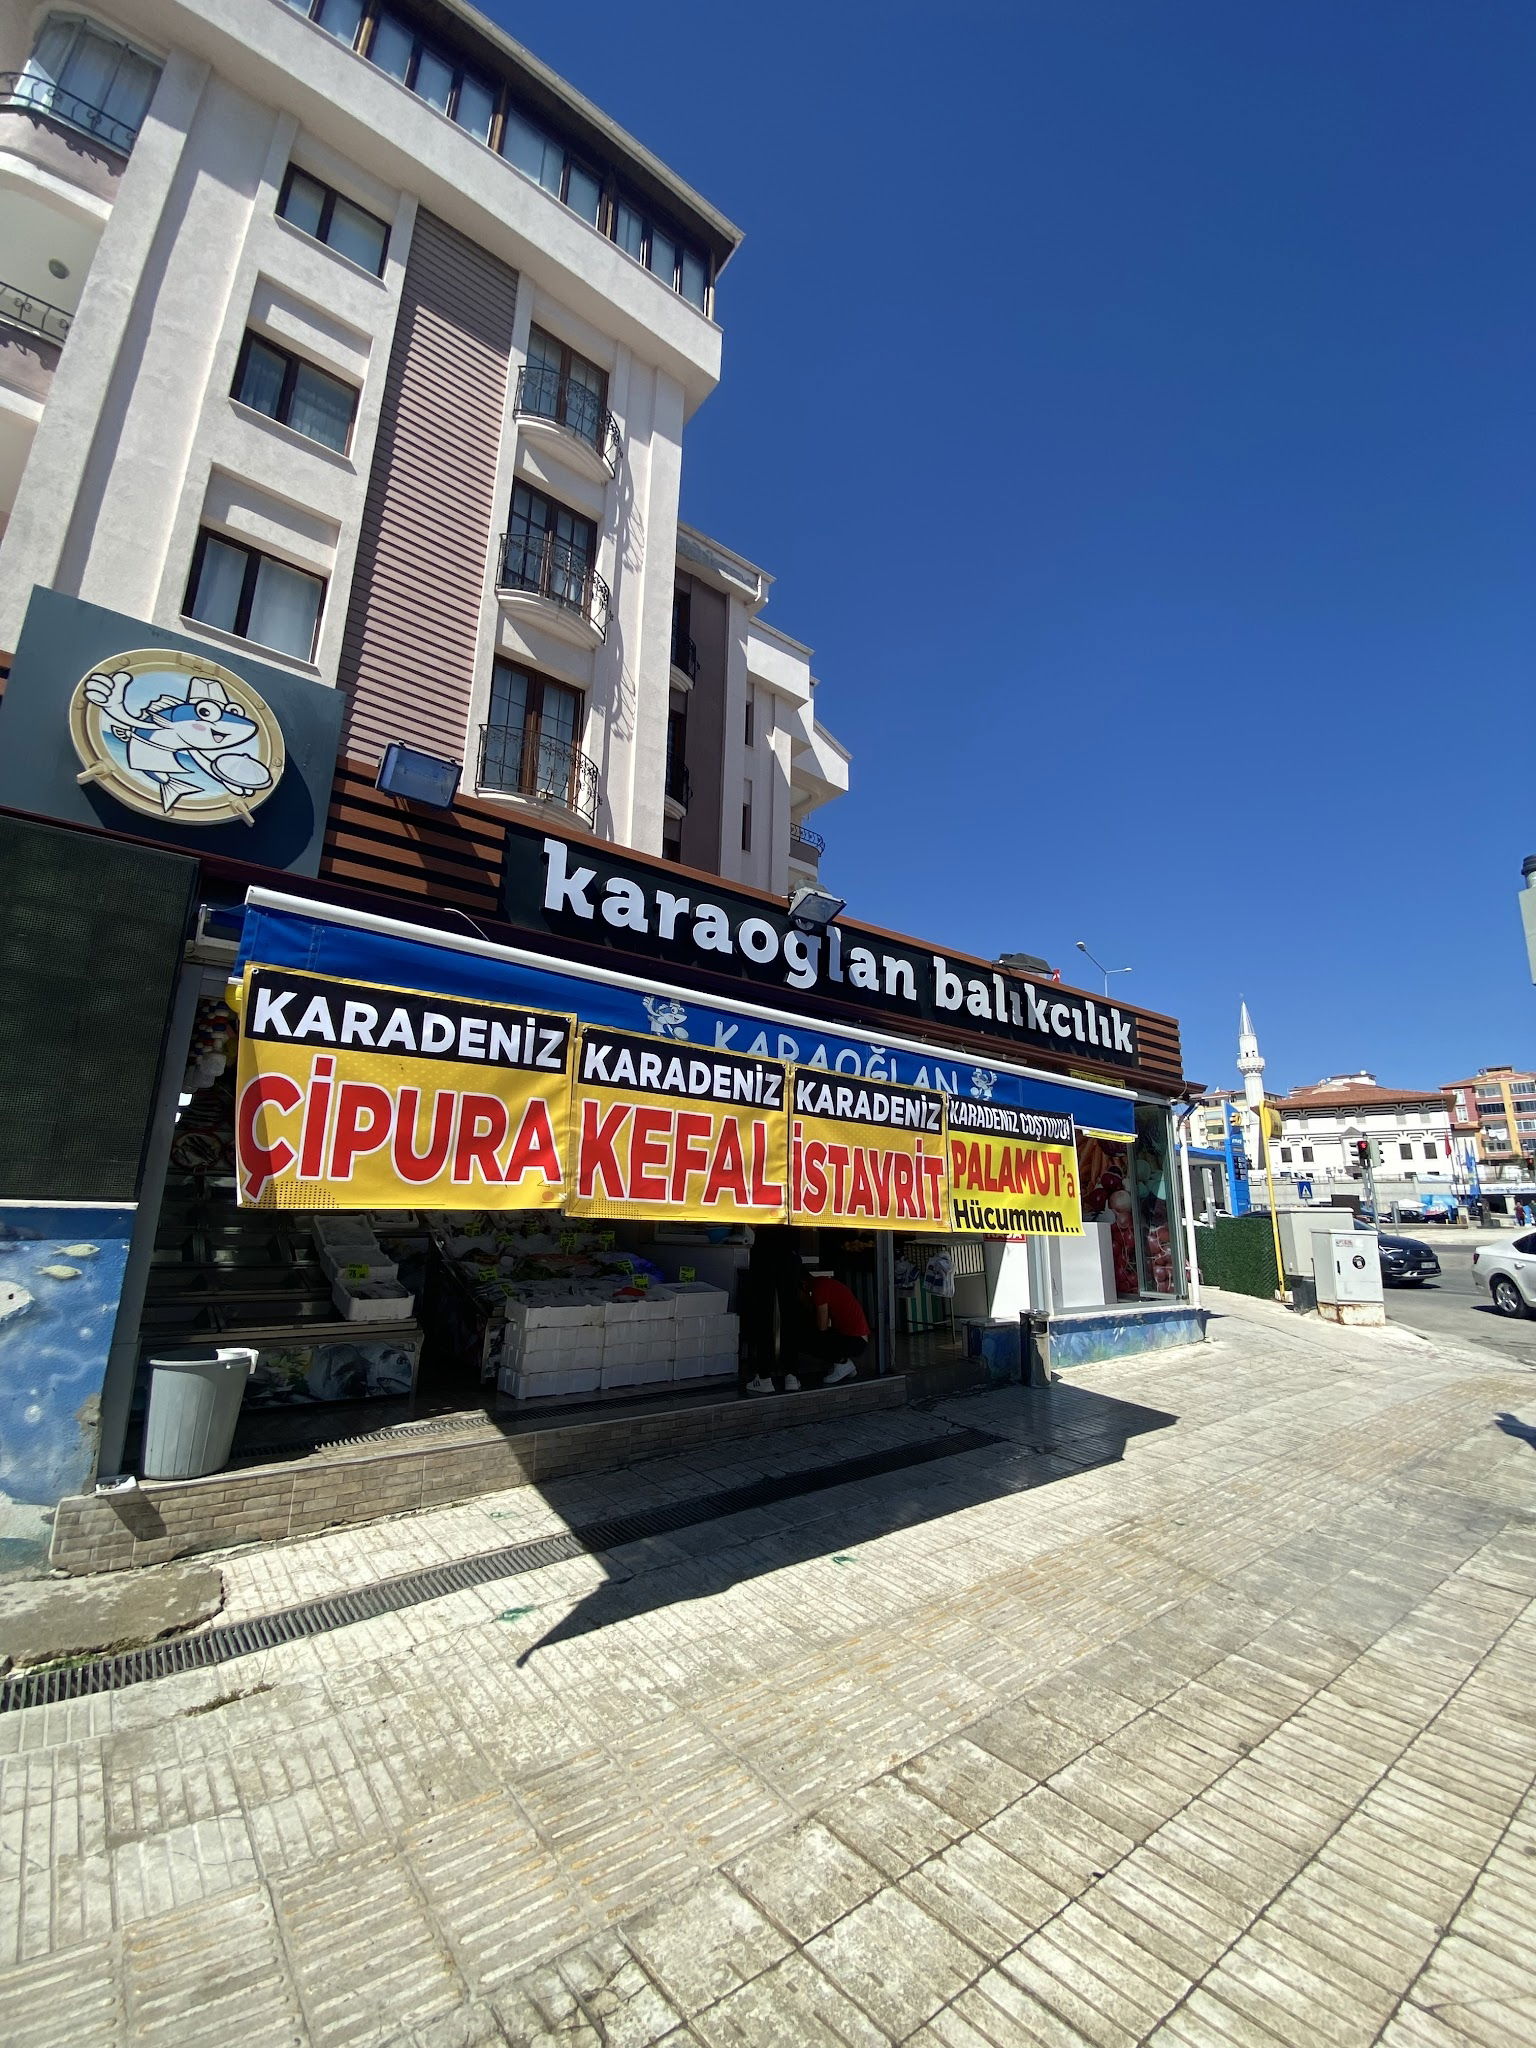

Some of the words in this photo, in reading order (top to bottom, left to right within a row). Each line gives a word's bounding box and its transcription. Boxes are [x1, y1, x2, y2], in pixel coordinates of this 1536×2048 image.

[544, 837, 918, 1000] karaoğlan
[933, 955, 1133, 1054] balıkcılık
[252, 988, 565, 1068] KARADENİZ
[583, 1042, 783, 1107] KARADENİZ
[796, 1079, 942, 1131] KARADENİZ
[949, 1100, 1020, 1133] KARADENİZ
[238, 1054, 565, 1202] ÇİPURA
[576, 1099, 785, 1206] KEFAL
[791, 1120, 944, 1221] İSTAVRİT
